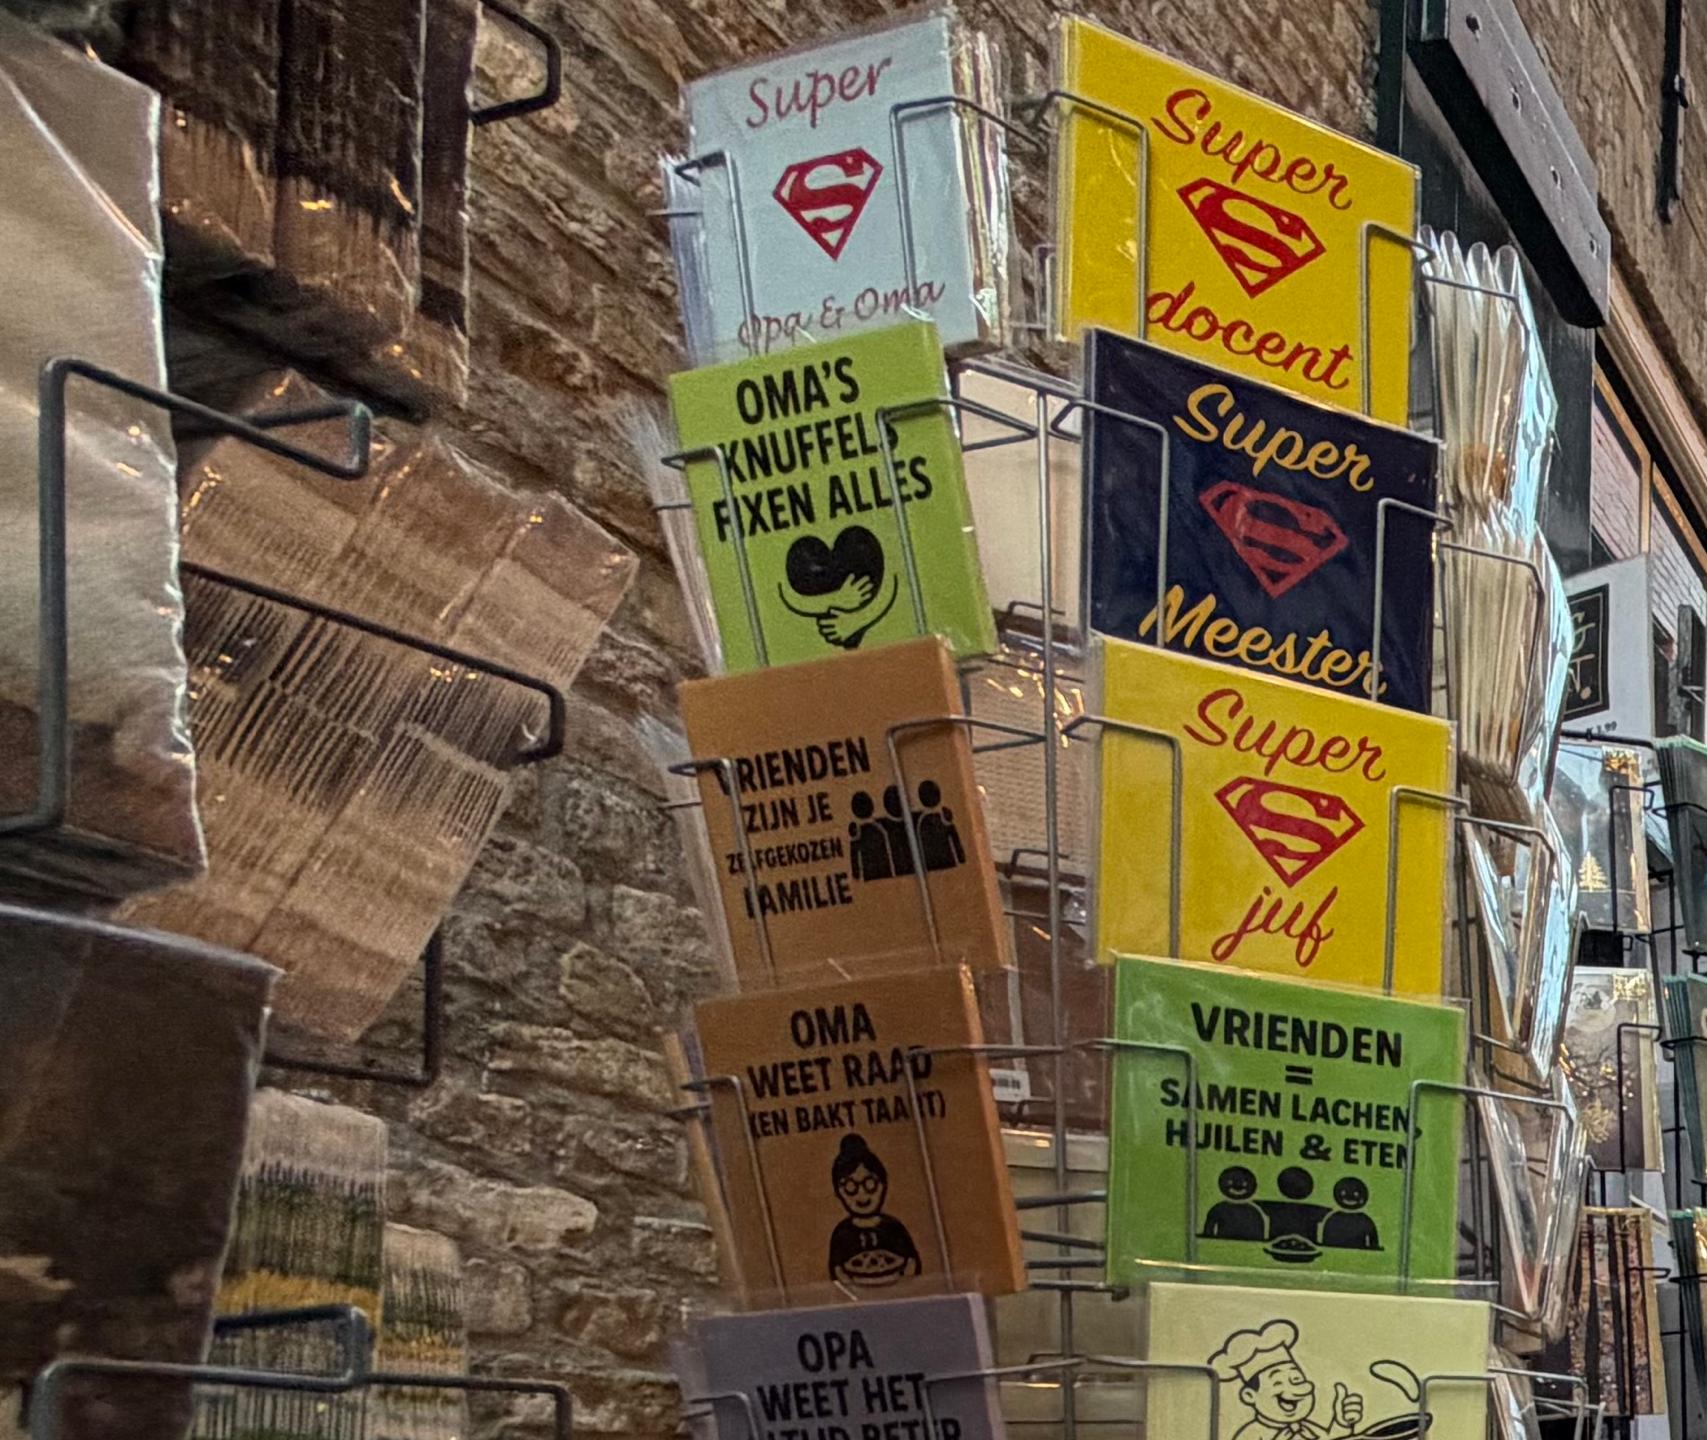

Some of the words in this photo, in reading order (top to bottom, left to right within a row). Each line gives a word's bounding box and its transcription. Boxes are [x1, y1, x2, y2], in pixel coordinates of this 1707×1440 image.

[746, 56, 892, 129] Super
[1151, 88, 1353, 211] Super
[854, 280, 946, 320] Oma
[1145, 281, 1354, 390] docent
[736, 356, 860, 425] OMA'S
[1172, 383, 1375, 492] Super
[713, 482, 816, 543] FIXEN
[829, 456, 933, 519] ALLES
[1138, 584, 1388, 695] Meester
[1183, 688, 1387, 782] Super
[741, 796, 800, 835] ZIJN
[806, 791, 833, 824] JE
[726, 836, 844, 875] ZEFGEKOZEN
[1211, 886, 1339, 968] juf
[790, 1002, 877, 1049] OMA
[1190, 1002, 1402, 1068] VRIENDEN
[747, 1056, 832, 1099] WEET
[842, 1044, 933, 1088] RAAD
[795, 1100, 856, 1133] BAKT
[1160, 1077, 1282, 1119] SAMEN
[1291, 1093, 1423, 1140] LACHEN,
[1165, 1118, 1284, 1157] HUILEN
[1299, 1133, 1332, 1162] &
[1343, 1137, 1415, 1170] ETEN
[796, 1329, 875, 1373] OPA
[756, 1378, 850, 1422] WEET
[861, 1372, 926, 1414] HET
